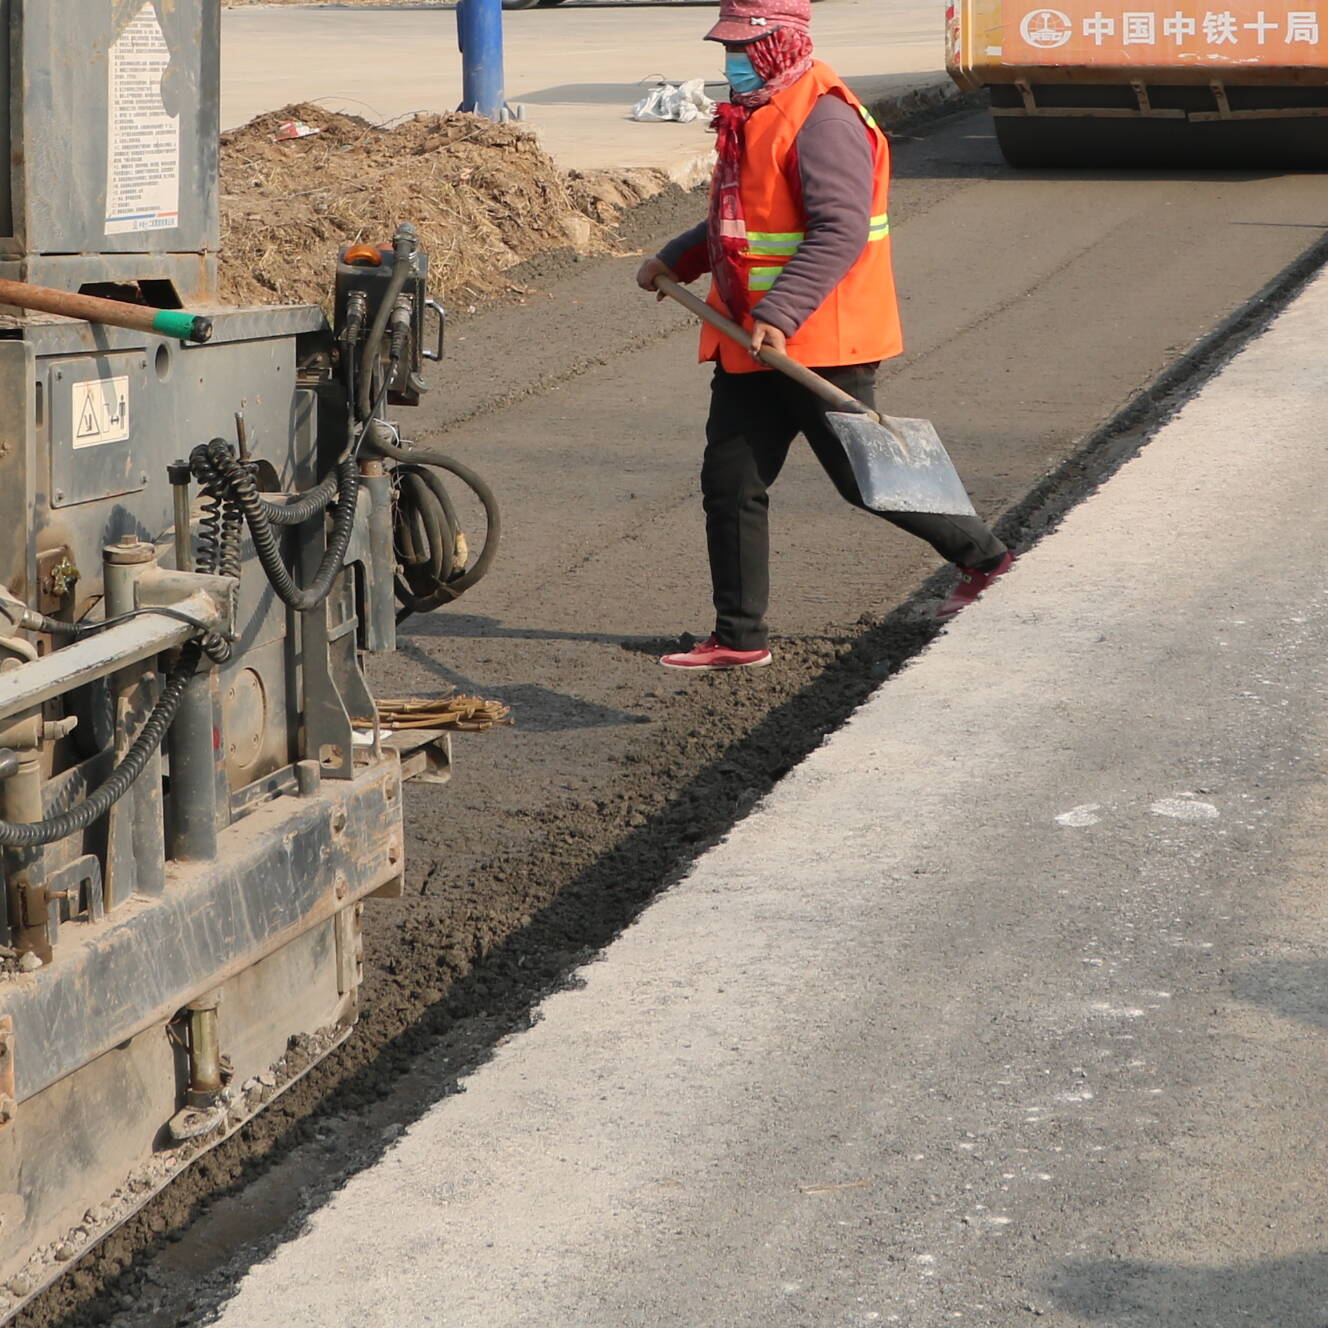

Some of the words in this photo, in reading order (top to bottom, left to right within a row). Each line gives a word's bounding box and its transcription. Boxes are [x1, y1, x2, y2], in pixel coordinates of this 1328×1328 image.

[1082, 10, 1320, 47] 中国中铁十局
